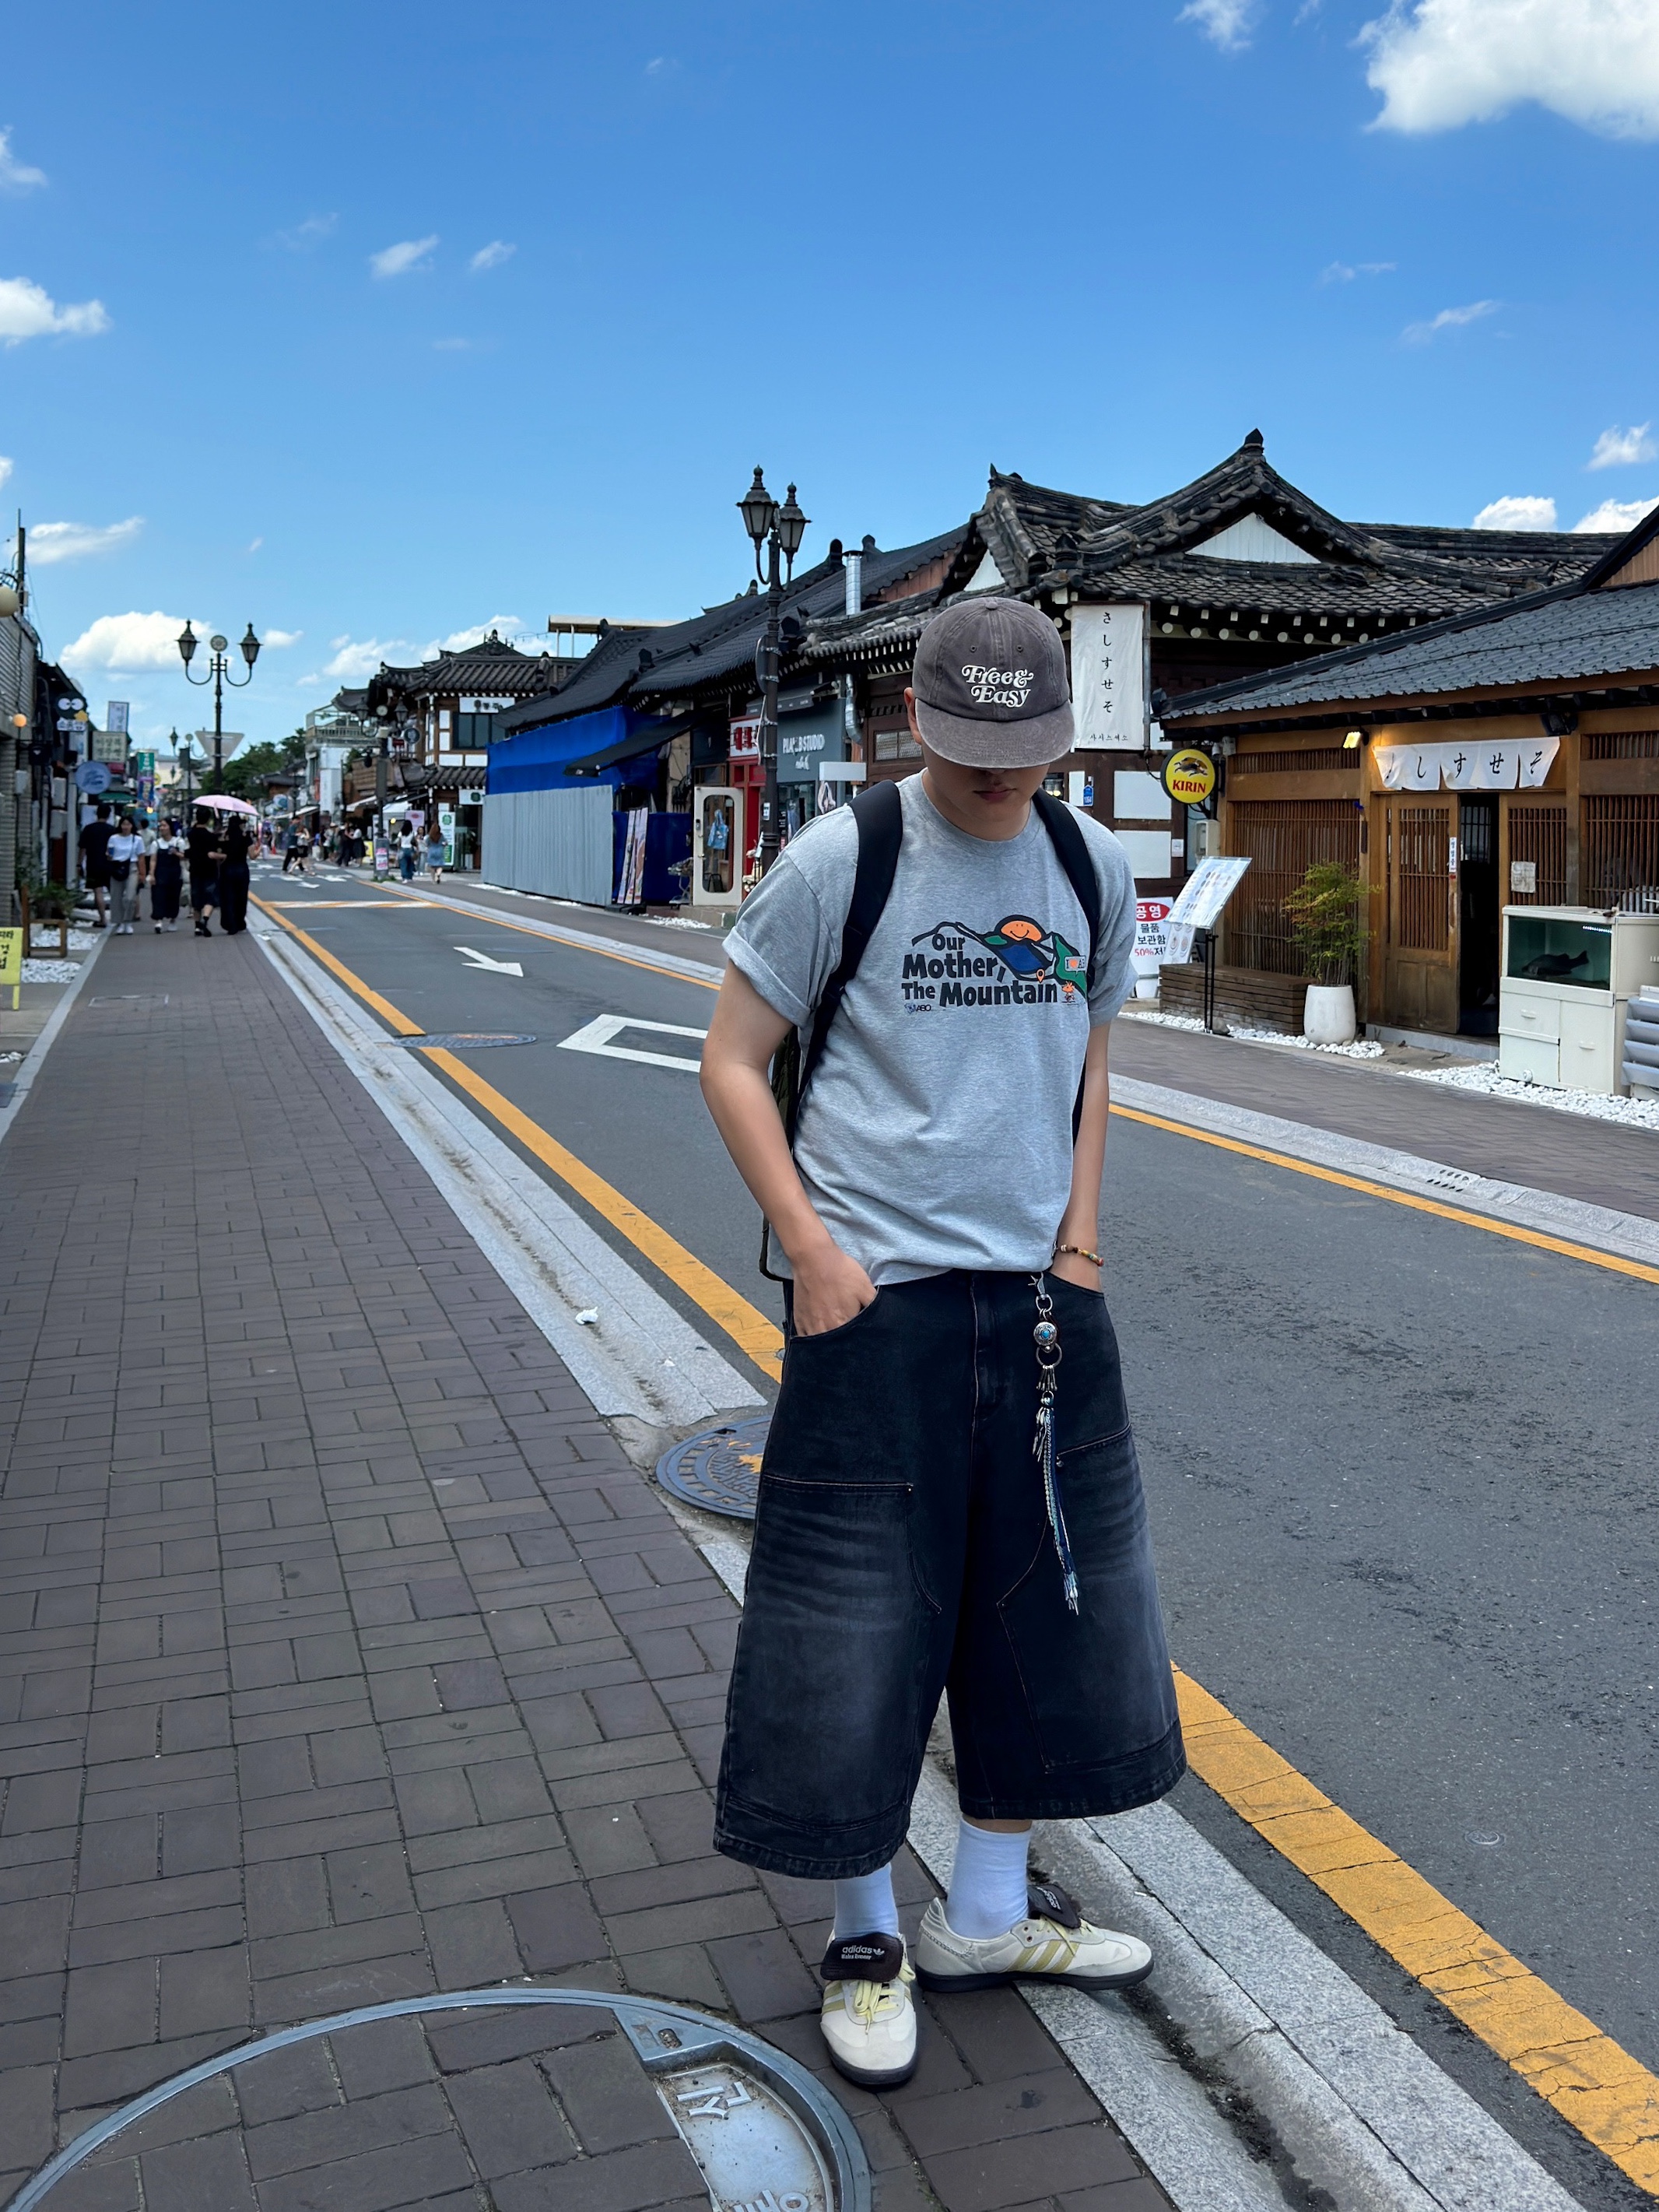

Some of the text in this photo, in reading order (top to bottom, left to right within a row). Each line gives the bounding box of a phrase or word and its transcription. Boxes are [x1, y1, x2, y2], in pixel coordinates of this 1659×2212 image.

[1101, 612, 1114, 713] さしすせそ
[962, 664, 1033, 689] Free&
[970, 685, 1031, 708] Easy
[1173, 779, 1206, 794] KIRIN
[1136, 904, 1161, 919] 공영
[1140, 923, 1159, 934] 물품
[931, 932, 966, 950] Our
[1138, 935, 1166, 945] 보관함
[1135, 946, 1166, 957] 50%저
[901, 951, 1006, 983] Mother,
[901, 980, 1058, 1007] The Mountain
[842, 1945, 872, 1954] adidas
